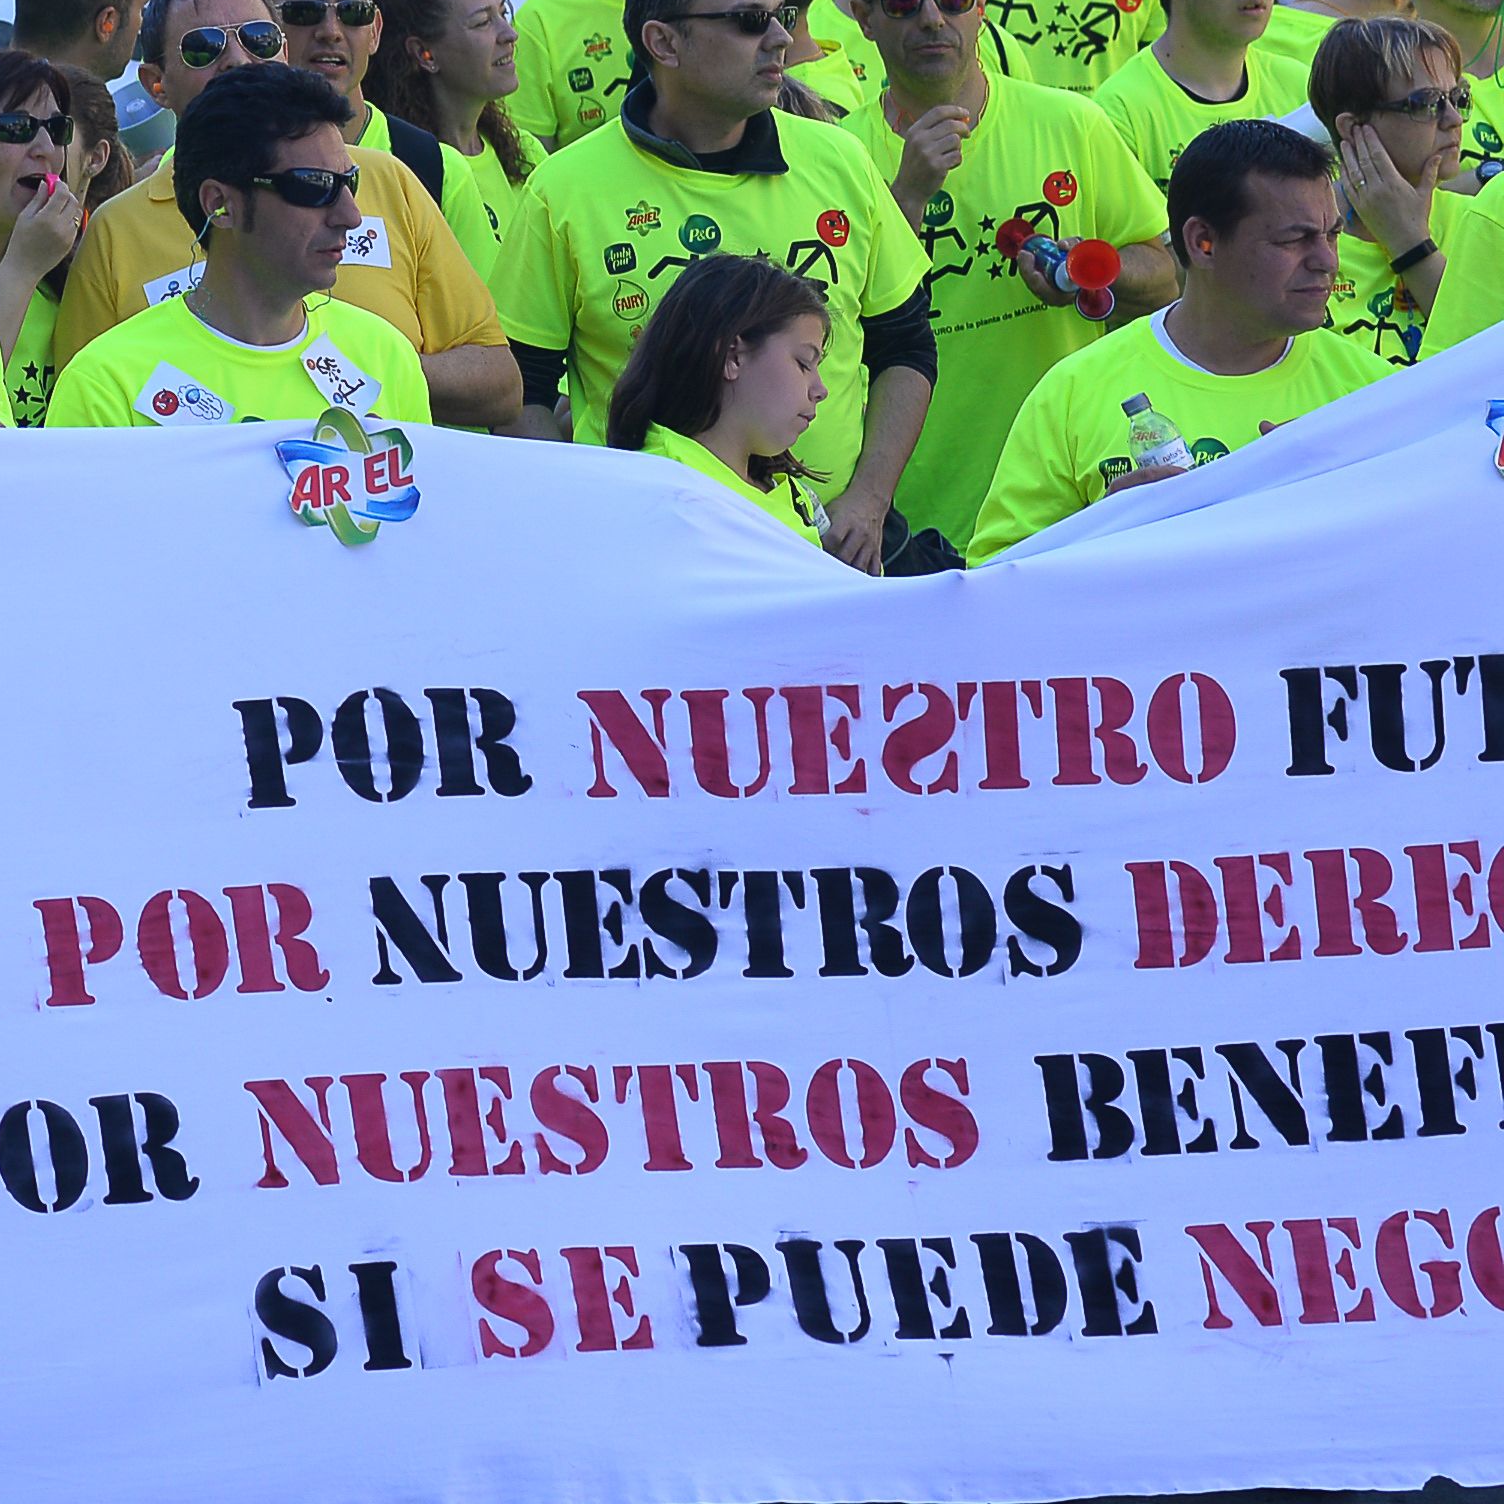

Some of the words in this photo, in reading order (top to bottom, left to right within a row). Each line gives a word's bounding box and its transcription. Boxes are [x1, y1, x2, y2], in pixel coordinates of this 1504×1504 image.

[926, 198, 950, 217] P&G
[627, 211, 659, 227] ARIEL
[688, 224, 717, 243] P&G
[615, 292, 646, 311] FAIRY
[954, 323, 965, 333] de
[966, 321, 975, 330] la
[976, 316, 1001, 329] planta
[1002, 312, 1012, 321] de
[232, 686, 534, 809] POR
[577, 671, 1237, 798] NUESTRO
[33, 882, 331, 1007] POR
[369, 863, 1083, 985] NUESTROS
[1125, 839, 1504, 970] DERE
[243, 1056, 980, 1189] NUESTROS
[1034, 1022, 1504, 1163] BENEF
[254, 1259, 414, 1382] SI
[470, 1244, 654, 1359] SE
[678, 1224, 1160, 1347] PUEDE
